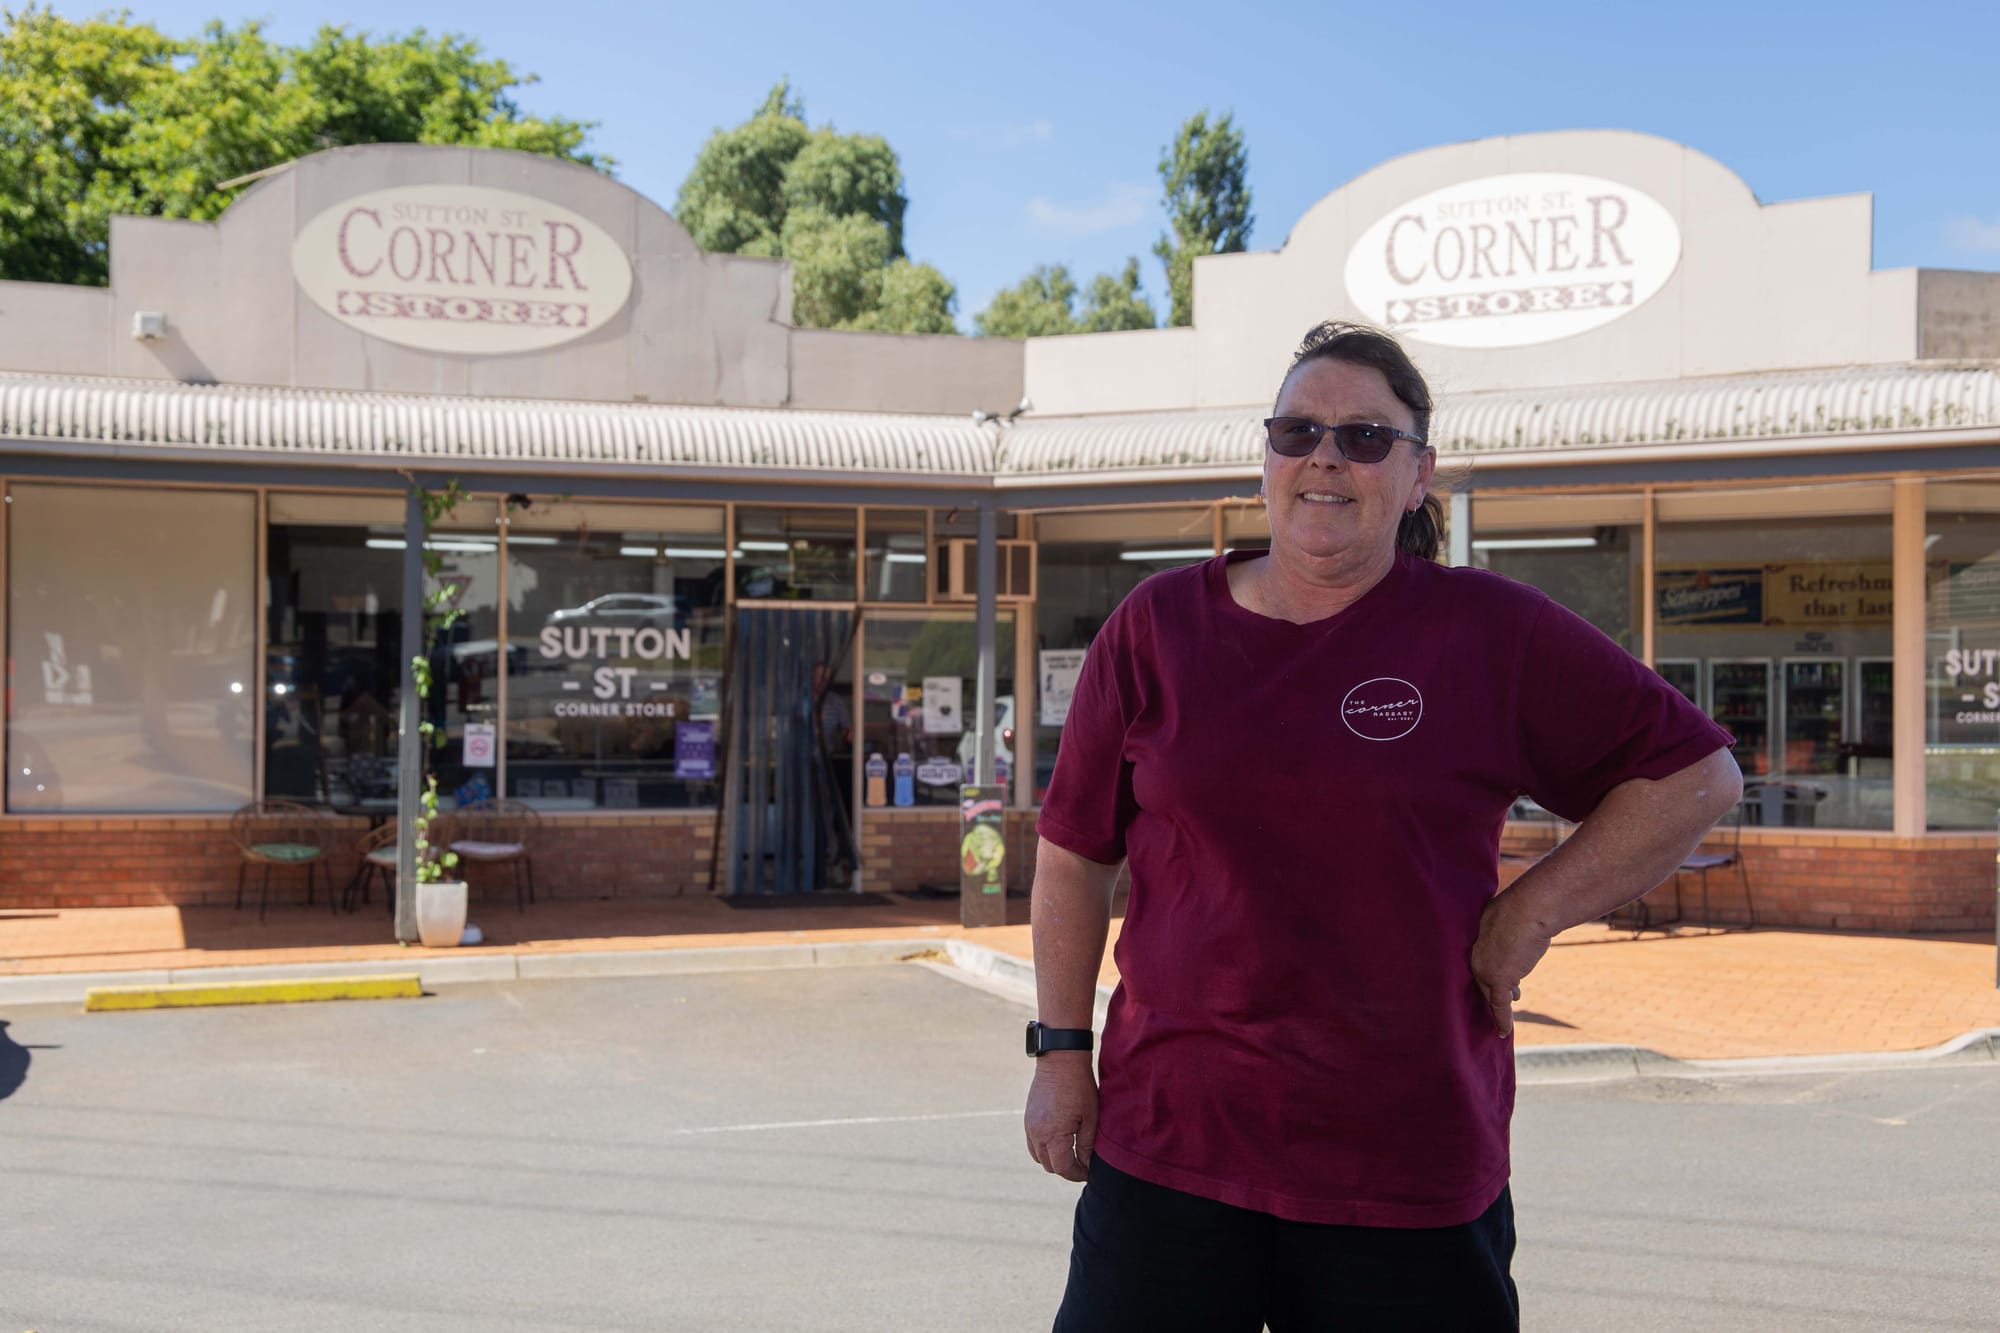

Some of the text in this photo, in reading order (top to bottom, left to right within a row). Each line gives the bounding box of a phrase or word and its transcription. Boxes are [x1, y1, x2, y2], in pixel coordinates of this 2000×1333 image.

[391, 203, 489, 226] SUTTON
[1437, 196, 1529, 219] SUTTON
[337, 206, 588, 291] CORNER
[1385, 194, 1634, 286] CORNER
[368, 294, 561, 325] STORE
[1414, 285, 1603, 321] STORE
[1804, 599, 1847, 617] that
[539, 626, 691, 660] SUTTON
[1945, 649, 2000, 676] SUT
[593, 666, 638, 699] ST
[1983, 681, 2000, 709] S
[554, 702, 675, 717] CORNER STORE
[1345, 699, 1419, 713] corner
